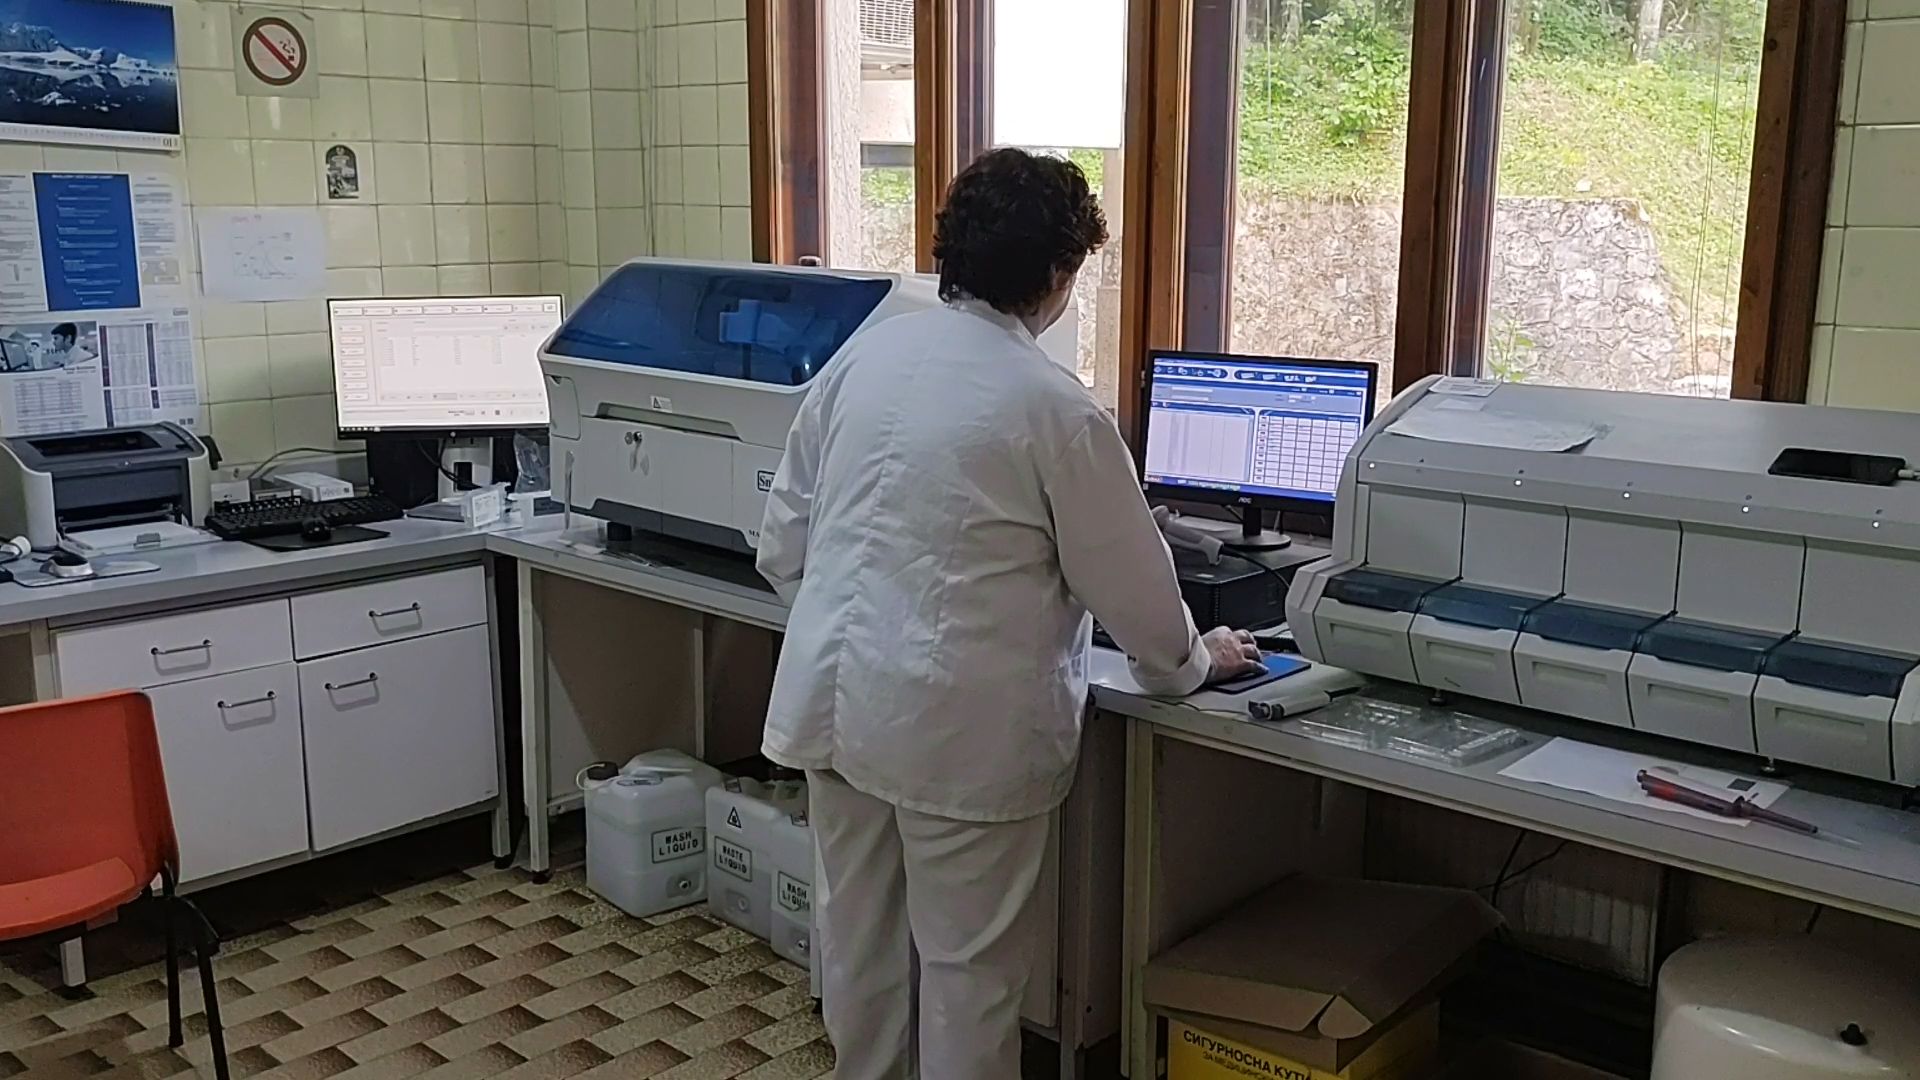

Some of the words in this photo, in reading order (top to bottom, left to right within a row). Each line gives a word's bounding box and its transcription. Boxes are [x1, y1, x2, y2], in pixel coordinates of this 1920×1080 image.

[665, 831, 692, 844] WASH
[659, 839, 698, 855] LIQUID
[722, 845, 744, 862] WASTE
[719, 855, 747, 873] LIQUID
[787, 882, 807, 900] WASH
[1183, 1030, 1271, 1073] СИГУРНОСНА
